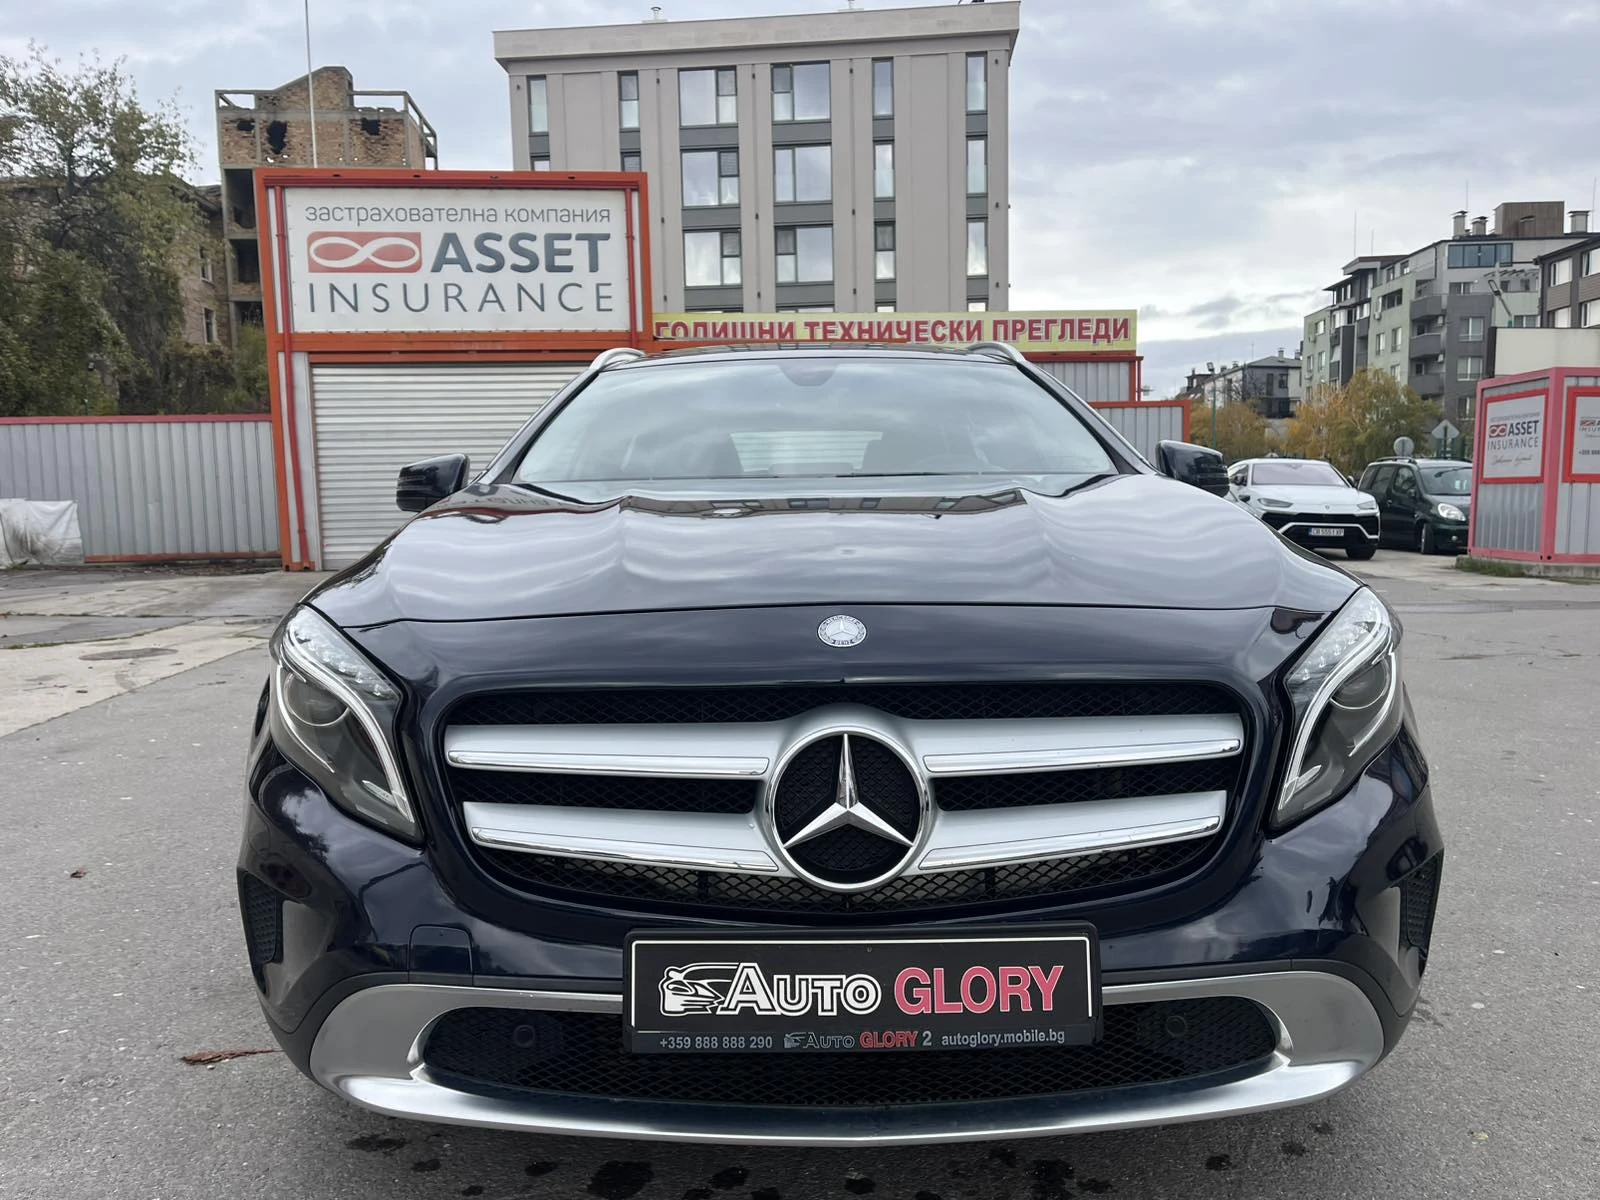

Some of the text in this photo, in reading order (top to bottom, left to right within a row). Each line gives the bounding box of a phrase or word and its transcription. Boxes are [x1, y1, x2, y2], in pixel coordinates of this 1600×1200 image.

[305, 205, 611, 226] застрахователна компания
[430, 232, 611, 273] ASSET
[309, 282, 613, 313] INSURANCE
[804, 319, 984, 342] ТЕХНИЧЕСКИ
[992, 317, 1130, 343] ПРЕГЛЕДИ
[1508, 420, 1539, 437] ASSET
[1488, 437, 1539, 450] INSURANCE
[894, 965, 1065, 1015] GLORY
[660, 1037, 691, 1049] +359
[695, 1037, 719, 1049] 888
[722, 1036, 746, 1049] 888
[749, 1036, 773, 1048] 290
[859, 1031, 918, 1049] GLORY
[922, 1033, 932, 1047] 2
[941, 1029, 1066, 1046] autoglory.mobile.bg
